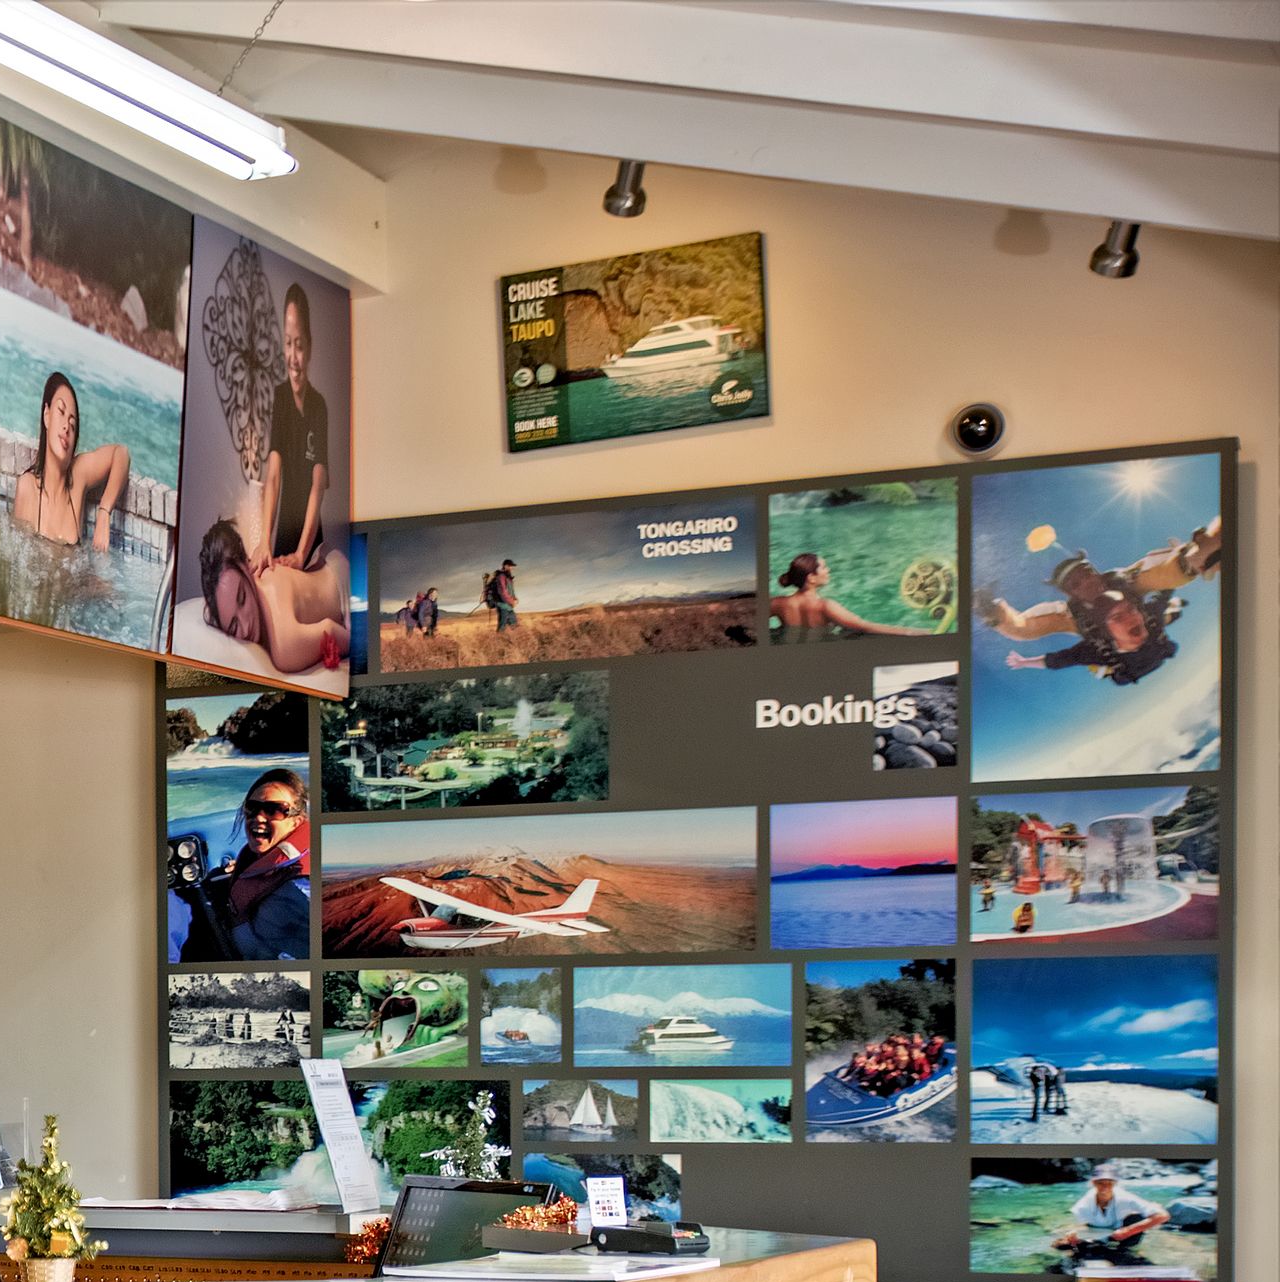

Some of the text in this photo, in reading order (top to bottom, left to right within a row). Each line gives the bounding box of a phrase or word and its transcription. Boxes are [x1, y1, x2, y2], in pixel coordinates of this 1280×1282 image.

[507, 277, 559, 303] CRUISE
[509, 300, 546, 323] LAKE
[511, 318, 556, 343] TAUPO
[514, 415, 558, 432] BOOK HERE
[638, 516, 738, 539] TONGARIRO
[642, 536, 732, 558] CROSSING
[756, 694, 917, 729] Bookings
